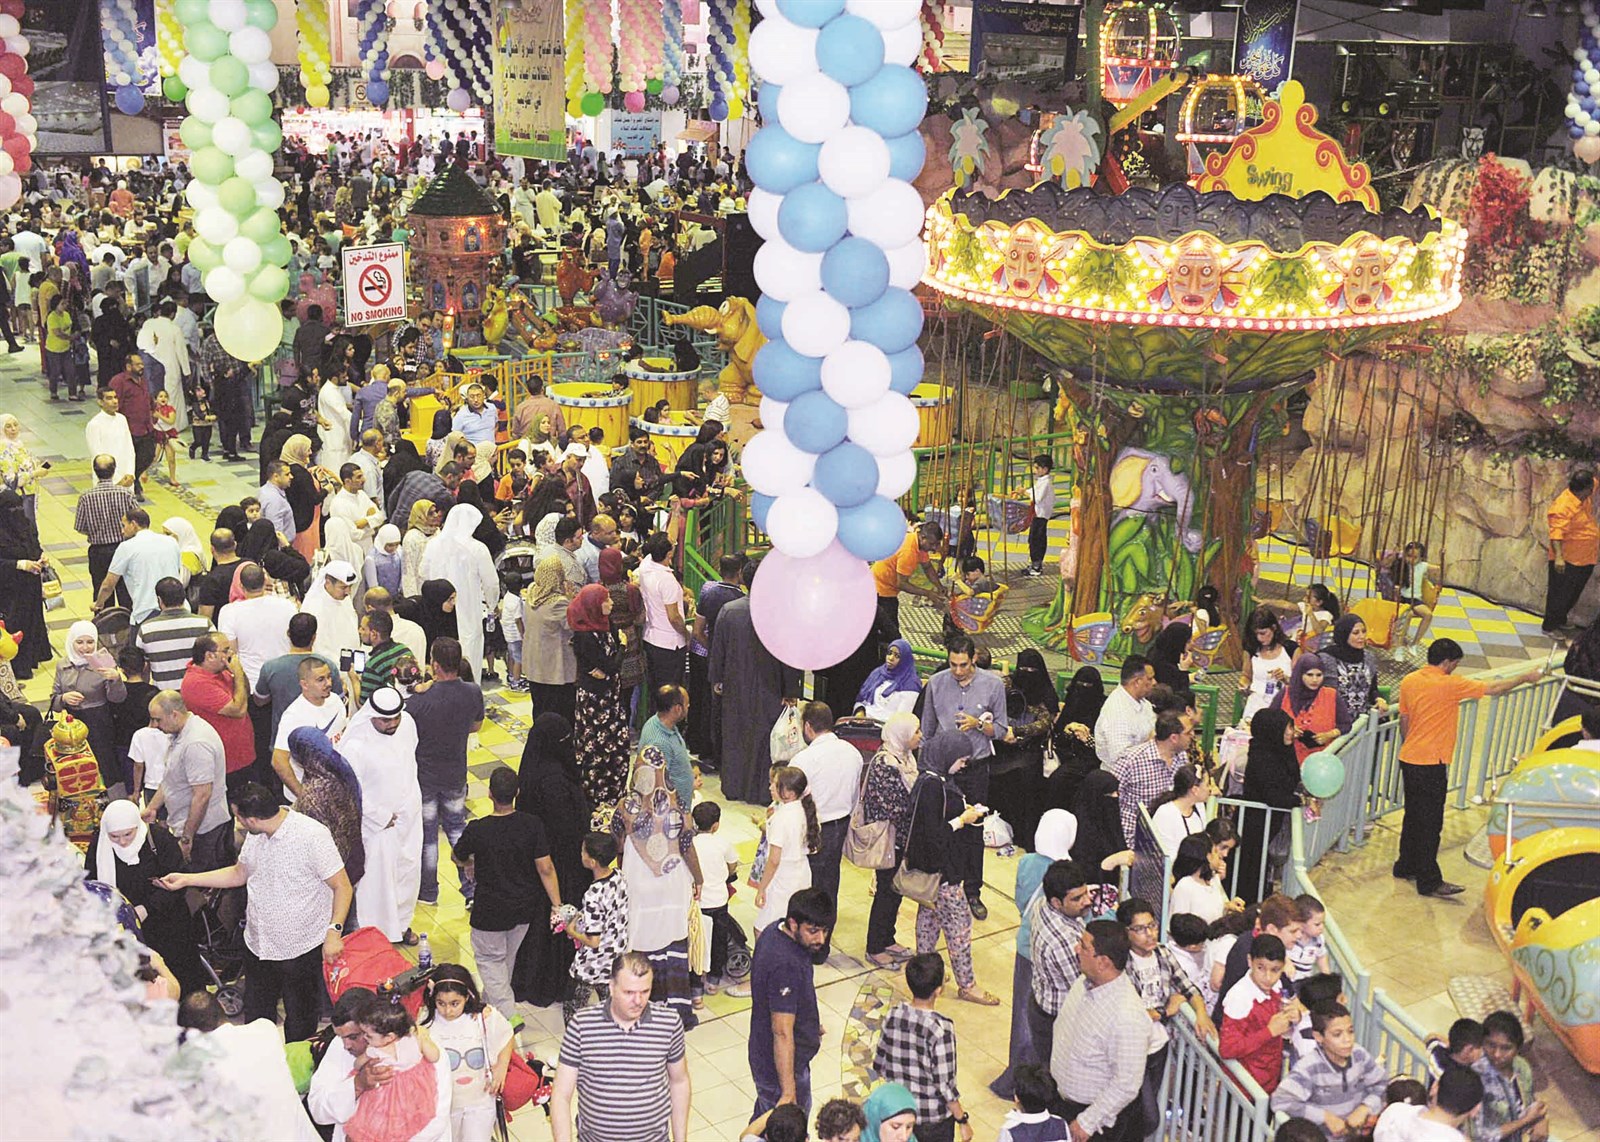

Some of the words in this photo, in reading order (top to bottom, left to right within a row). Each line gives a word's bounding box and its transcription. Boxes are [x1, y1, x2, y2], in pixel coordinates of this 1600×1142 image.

[1247, 164, 1293, 192] Swing
[349, 251, 378, 265] التدخين
[379, 248, 398, 262] ممنوع
[351, 312, 363, 322] NO
[365, 306, 403, 320] SMOKING
